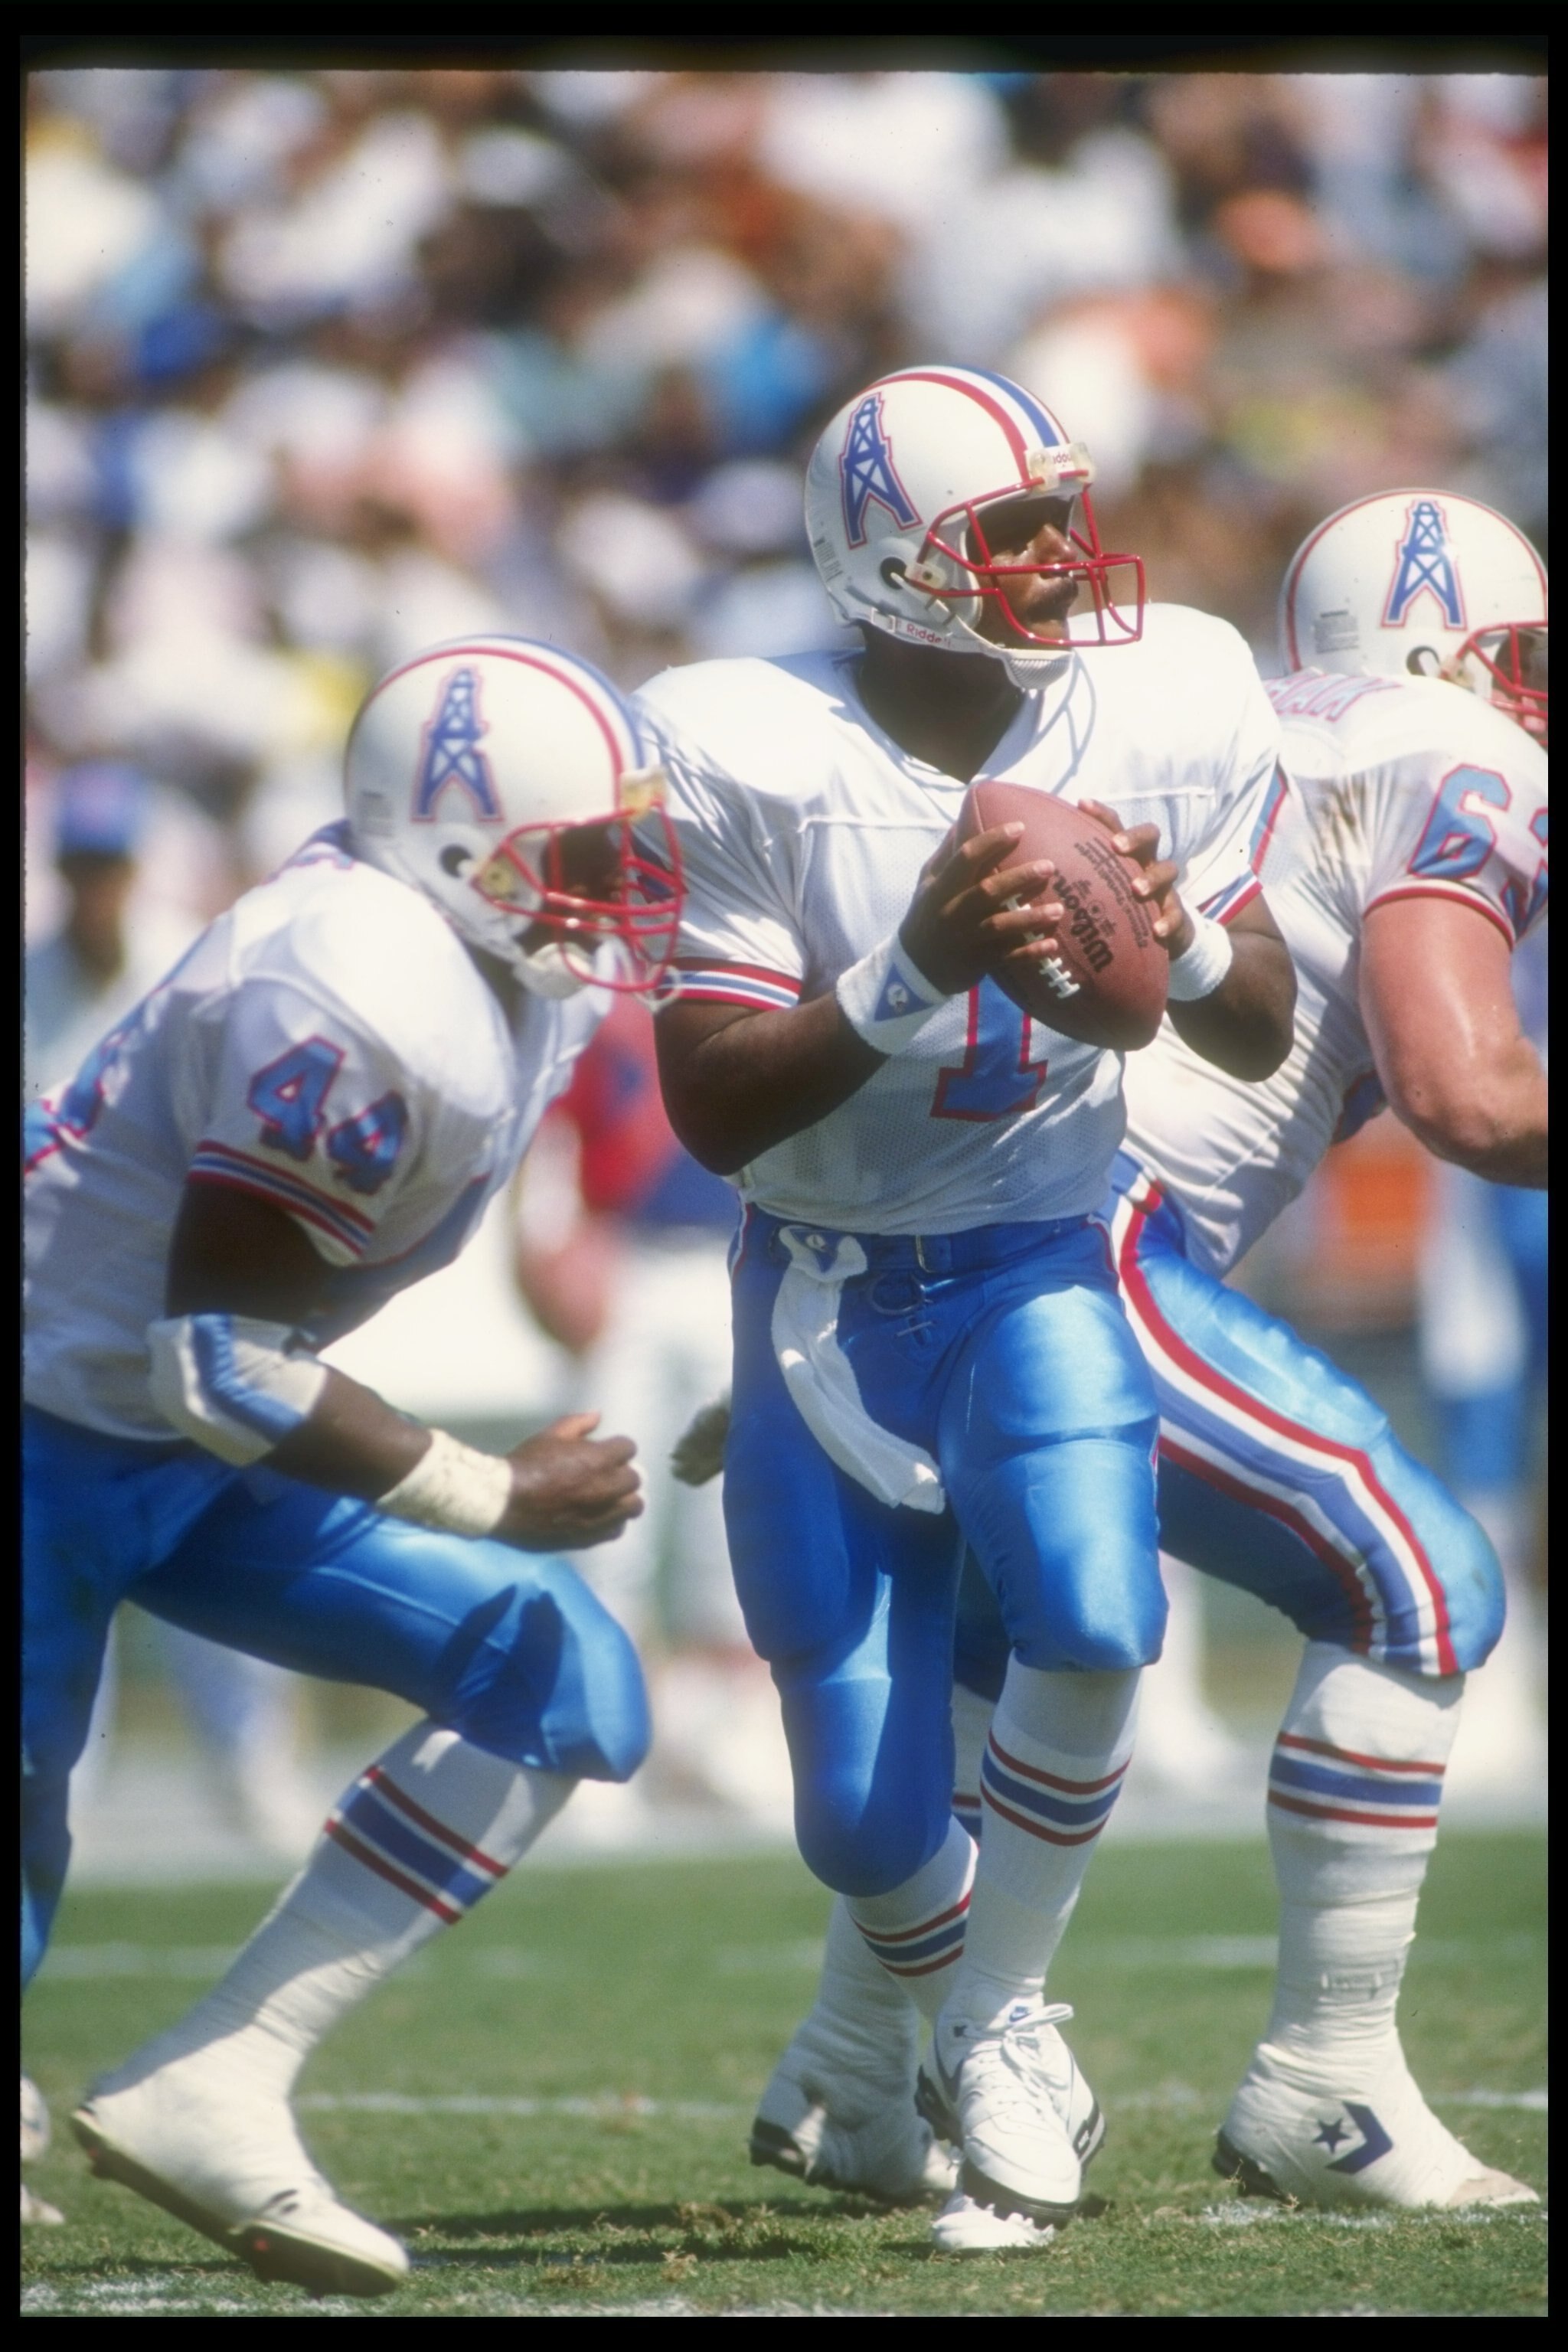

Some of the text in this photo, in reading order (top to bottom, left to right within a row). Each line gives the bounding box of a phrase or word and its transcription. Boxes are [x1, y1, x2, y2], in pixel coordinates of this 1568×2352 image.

[1052, 875, 1114, 973] Wilson
[247, 1035, 408, 1195] 44
[929, 974, 1048, 1122] 1
